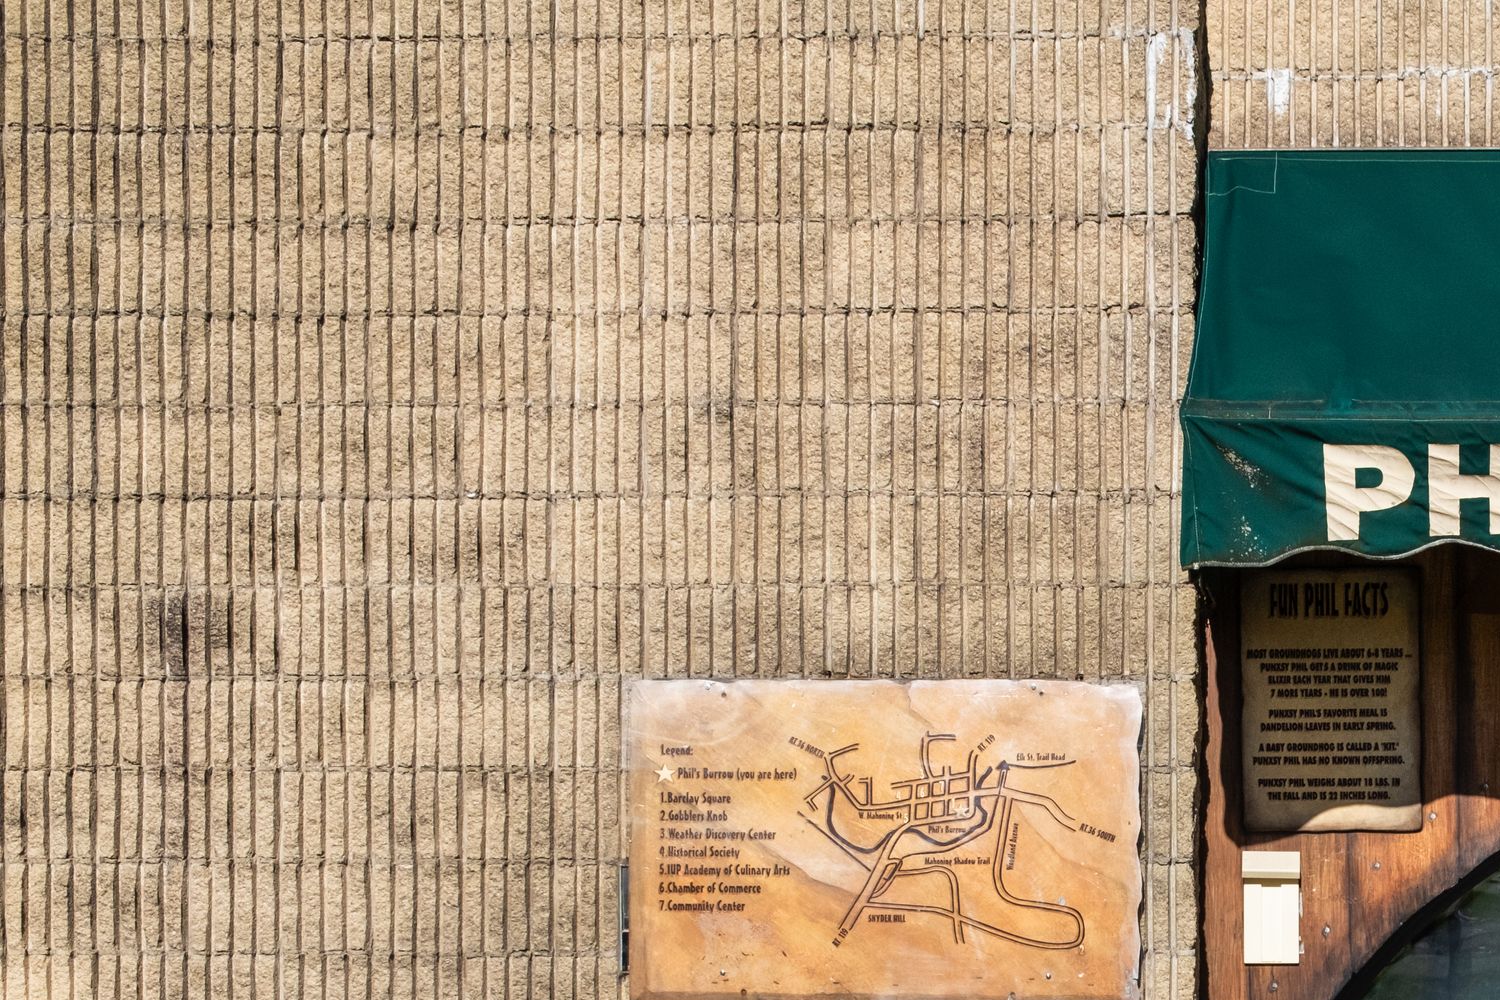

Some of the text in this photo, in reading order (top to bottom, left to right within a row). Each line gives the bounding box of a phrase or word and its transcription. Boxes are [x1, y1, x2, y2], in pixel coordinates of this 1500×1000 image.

[1269, 582, 1388, 617] FUN PHIL FACTS
[1268, 649, 1321, 659] GROUNDHOGS
[1323, 649, 1338, 659] LIVE
[1340, 649, 1365, 659] ABOUT
[1381, 649, 1403, 659] YEARS
[1260, 662, 1289, 672] PUNXSY
[1291, 662, 1308, 672] PHIL
[1330, 662, 1335, 672] A
[1363, 662, 1372, 672] OF
[1268, 675, 1291, 685] ELIXIR
[1292, 675, 1311, 685] EACH
[1313, 675, 1331, 685] YEAR
[1332, 675, 1351, 685] THAT
[1353, 675, 1374, 685] GIVES
[1270, 688, 1275, 698] 7
[1277, 688, 1298, 698] MORE
[1300, 688, 1322, 698] YEARS
[1329, 688, 1339, 698] HE
[1341, 688, 1348, 698] IS
[1350, 688, 1369, 698] OVER
[1268, 709, 1297, 718] PUNXSY
[1323, 709, 1358, 718] FAVORITE
[1359, 709, 1379, 718] MEAL
[1380, 709, 1388, 718] IS
[1260, 722, 1303, 732] DANDELION
[1305, 722, 1330, 732] LEAVES
[1343, 722, 1364, 732] EARLY
[661, 744, 693, 757] Legend:
[1259, 742, 1264, 752] A
[1286, 742, 1335, 752] GROUNDHOG
[1336, 742, 1344, 752] IS
[1346, 742, 1372, 752] CALLED
[1374, 742, 1379, 752] A
[1252, 755, 1282, 766] PUNXSY
[1283, 755, 1300, 766] PHIL
[1302, 755, 1317, 766] HAS
[1318, 755, 1330, 766] NO
[678, 767, 797, 781] Phil's Burrow (you are here)
[1258, 778, 1286, 788] PUNXSY
[1288, 778, 1305, 788] PHIL
[1307, 778, 1335, 788] WEIGHS
[1337, 778, 1361, 788] ABOUT
[1364, 778, 1373, 788] 18
[703, 792, 731, 805] Square
[1267, 791, 1281, 801] THE
[1282, 791, 1300, 801] FALL
[1301, 791, 1318, 801] AND
[1319, 791, 1327, 801] IS
[1328, 791, 1338, 801] 22
[1340, 791, 1366, 801] INCHES
[707, 810, 727, 822] Knob
[866, 812, 894, 821] Mahoning
[706, 828, 745, 841] Discovery
[749, 828, 776, 840] Center
[1097, 830, 1116, 843] SOUTH
[710, 846, 740, 859] Society
[924, 857, 952, 866] Mahoning
[954, 857, 976, 865] Shadow
[684, 864, 721, 877] Academy
[724, 864, 732, 875] of
[736, 864, 771, 877] Culinary
[774, 864, 790, 875] Arts
[707, 883, 715, 893] of
[719, 883, 761, 894] Commerce
[717, 900, 745, 912] Center
